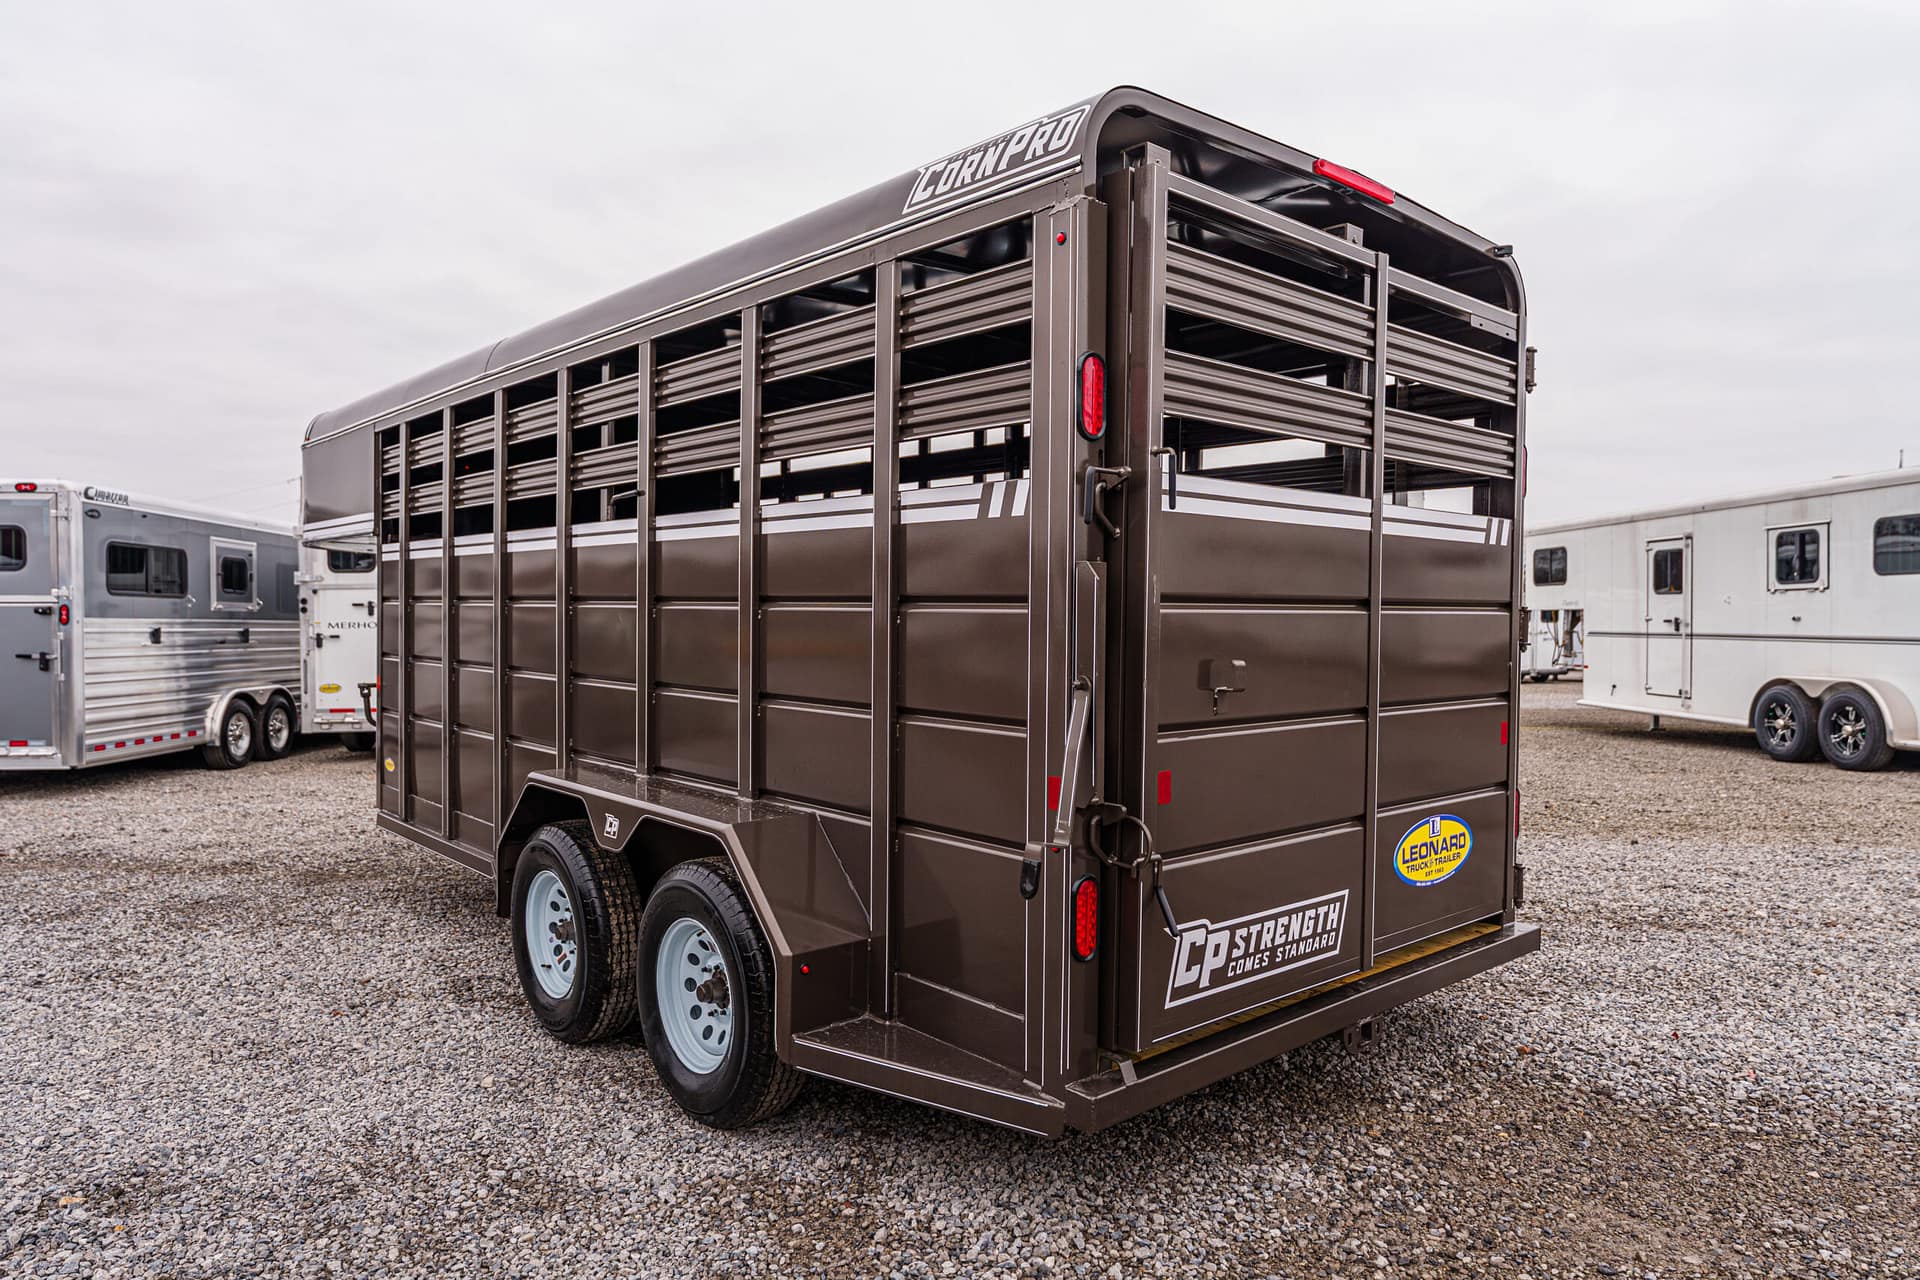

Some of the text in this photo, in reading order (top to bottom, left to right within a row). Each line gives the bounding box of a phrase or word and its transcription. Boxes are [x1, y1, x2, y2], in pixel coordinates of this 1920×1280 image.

[1402, 832, 1466, 864] LEONARD
[1406, 861, 1429, 873] TRUCK
[1435, 852, 1461, 866] TRAILER
[1173, 902, 1341, 989] CP STRENGTH
[1227, 932, 1336, 977] COMES STANDARD
